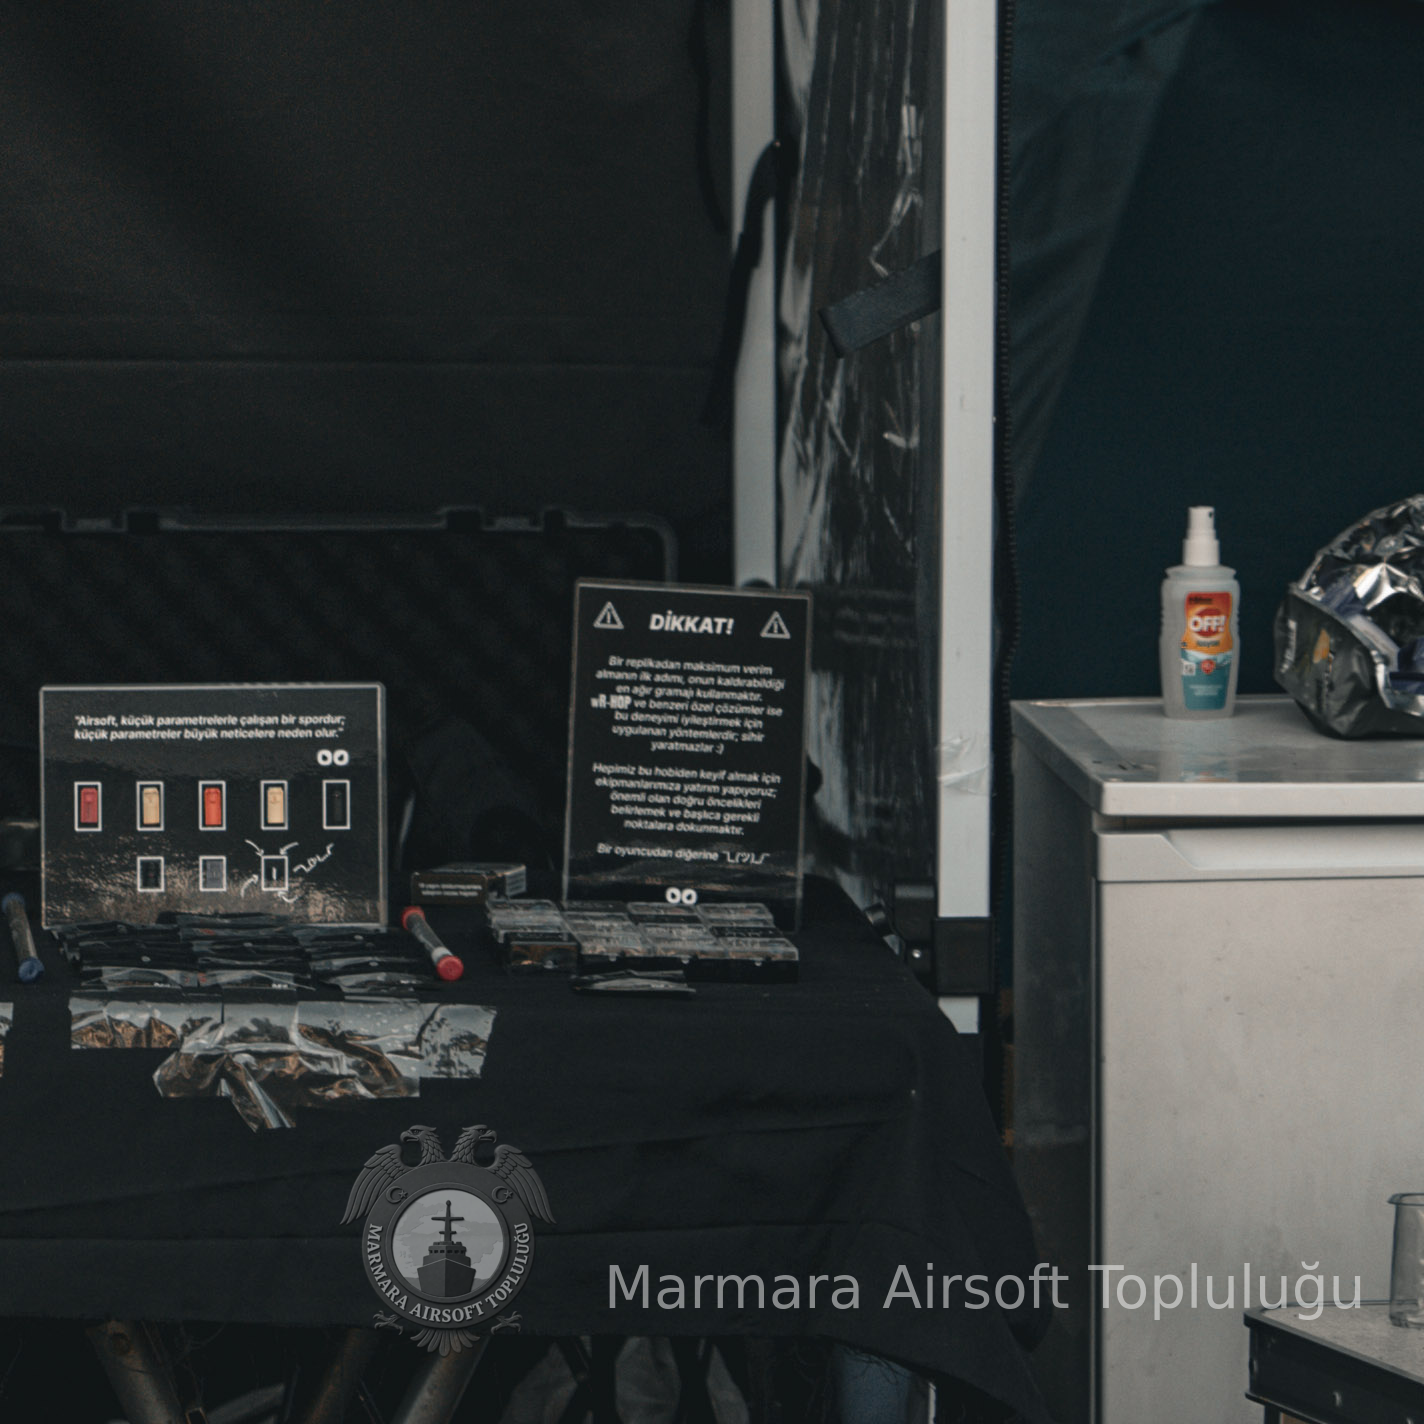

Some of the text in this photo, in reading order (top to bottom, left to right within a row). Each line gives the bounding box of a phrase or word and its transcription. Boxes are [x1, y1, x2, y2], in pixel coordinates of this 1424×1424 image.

[649, 610, 734, 635] DİKKAT!
[1189, 614, 1227, 633] OFF!
[120, 714, 156, 727] küçük
[156, 714, 240, 727] parametrelerle
[239, 714, 280, 727] çalışan
[280, 714, 298, 726] bir
[74, 728, 109, 740] küçük
[109, 727, 183, 740] parametreler
[183, 728, 220, 740] büyük
[219, 727, 277, 740] neticelere
[277, 727, 314, 739] neden
